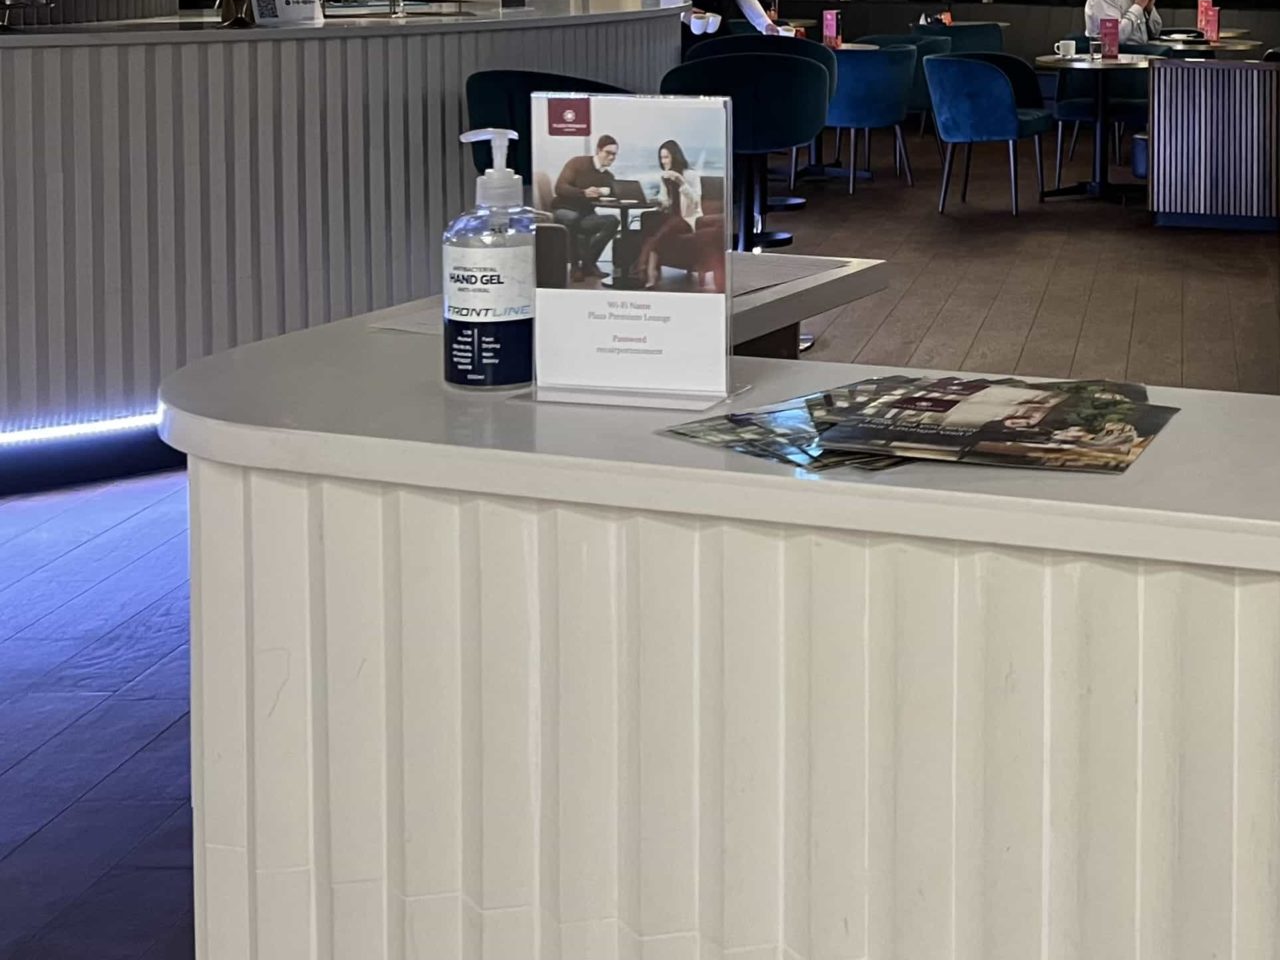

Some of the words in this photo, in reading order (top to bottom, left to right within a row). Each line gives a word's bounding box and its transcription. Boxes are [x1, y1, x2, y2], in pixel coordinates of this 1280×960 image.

[449, 273, 478, 285] HAND
[480, 274, 504, 285] GEL
[448, 305, 530, 317] FRONTLINE
[630, 302, 651, 310] Name
[588, 311, 607, 320] Plaza
[608, 312, 642, 321] Premium
[644, 313, 671, 323] Lounge
[612, 334, 647, 343] Password
